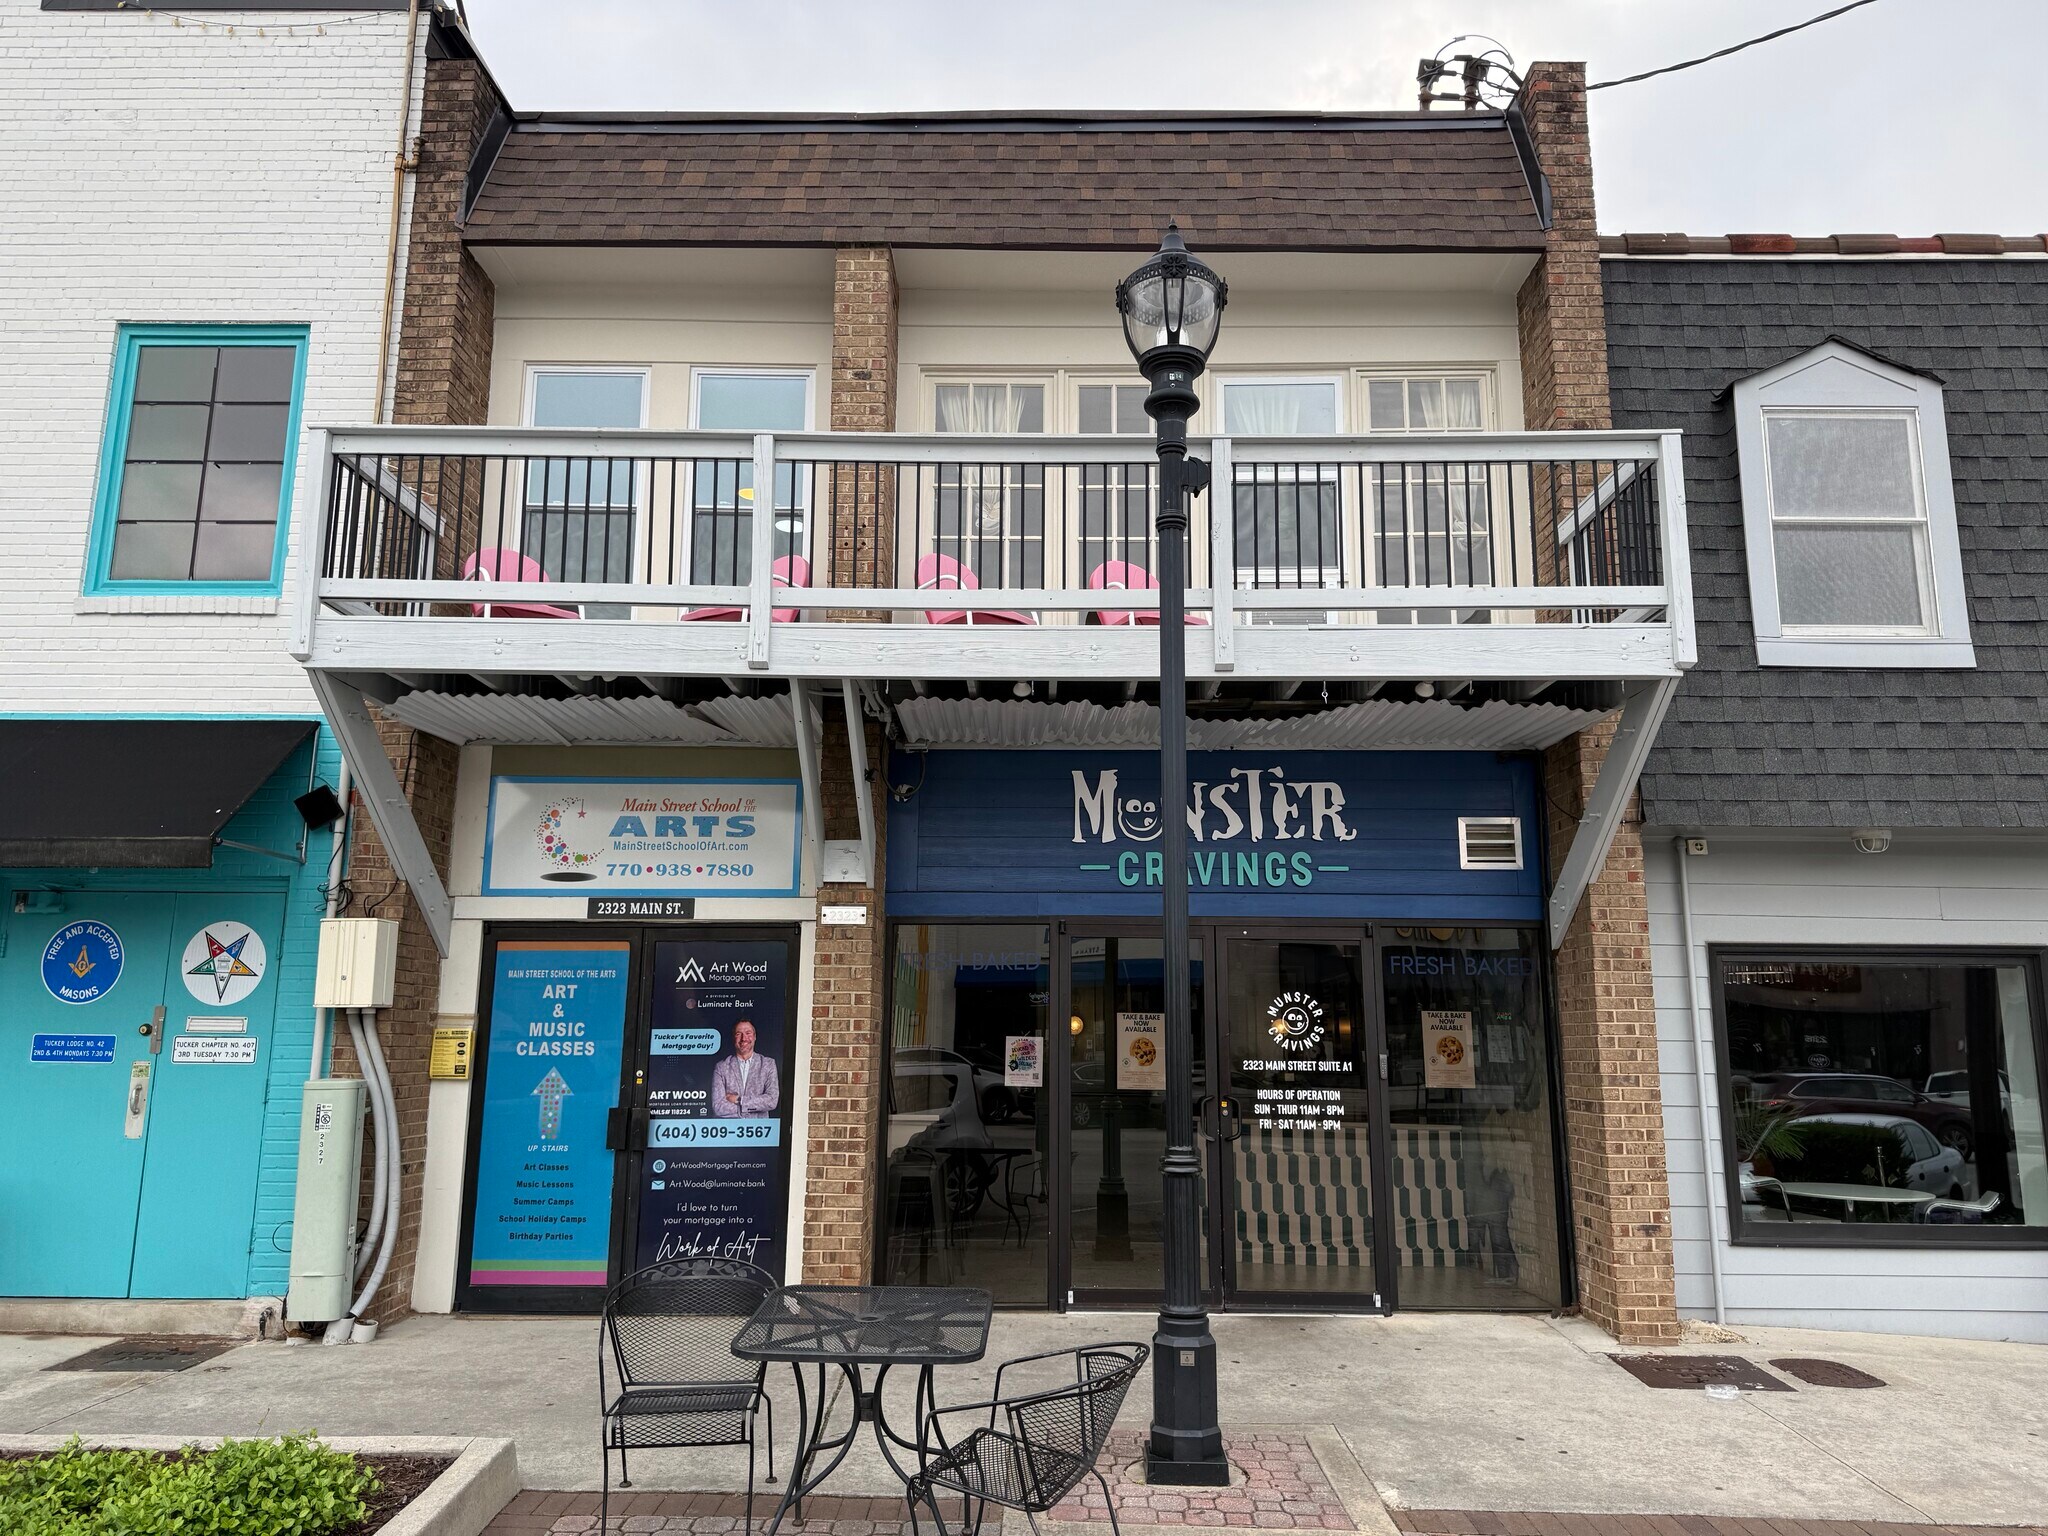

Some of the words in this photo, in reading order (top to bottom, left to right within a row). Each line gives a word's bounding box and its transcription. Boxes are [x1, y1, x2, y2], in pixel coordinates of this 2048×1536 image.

[620, 798, 656, 812] Main
[660, 798, 698, 812] Street
[699, 798, 742, 812] School
[608, 816, 756, 837] ARTS
[613, 841, 748, 851] MainStreetSchoolOfArt.com
[1118, 851, 1313, 887] CRVINGS
[598, 902, 626, 914] 2323
[630, 902, 662, 914] MAIN
[666, 902, 684, 914] ST.
[829, 910, 858, 921] 2323
[47, 938, 65, 960] FREE
[66, 926, 84, 939] AND
[86, 925, 119, 960] ACCEPTED
[710, 962, 728, 972] Art
[732, 961, 767, 972] Wood
[973, 952, 1041, 971] BAKED
[1390, 956, 1455, 975] FRESH
[1465, 957, 1534, 976] BAKED
[508, 970, 524, 978] MAIN
[525, 970, 548, 978] STREET
[550, 970, 574, 978] SCHOOL
[577, 970, 584, 978] OF
[587, 970, 598, 978] THE
[600, 970, 616, 978] ARTS
[709, 974, 745, 982] Mortgage
[59, 986, 99, 1000] MASONS
[542, 984, 578, 999] ART
[553, 1003, 564, 1018] &
[1267, 992, 1323, 1018] MUNSTER
[529, 1022, 585, 1037] MUSIC
[1268, 1026, 1324, 1051] CRAVINGS
[516, 1041, 595, 1056] CLASSES
[1243, 1060, 1264, 1070] 2323
[1265, 1060, 1286, 1070] MAIN
[1288, 1061, 1316, 1071] STREET
[1318, 1061, 1341, 1071] SUITE
[1343, 1062, 1352, 1071] A1
[650, 1091, 671, 1100] ART
[672, 1091, 707, 1100] WOOD
[1257, 1090, 1283, 1100] HOURS
[1285, 1090, 1295, 1100] OF
[1297, 1090, 1340, 1100] OPERATION
[1254, 1104, 1270, 1114] SUN
[1277, 1105, 1298, 1115] THUR
[1300, 1105, 1320, 1115] 11AM
[1327, 1105, 1344, 1116] 8PM
[1259, 1119, 1272, 1129] FRI
[1278, 1120, 1294, 1129] SAT
[1295, 1120, 1316, 1130] 11AM
[1324, 1120, 1341, 1130] 9PM
[655, 1124, 697, 1142] (404)
[701, 1126, 771, 1138] 909-3567
[670, 1161, 766, 1170] ArtWoodMortgageTeam.com
[669, 1179, 766, 1189] Art.Wood@luminate.bank
[548, 1198, 574, 1207] Camps
[677, 1203, 688, 1212] I'd
[690, 1203, 707, 1212] love
[710, 1204, 718, 1212] to
[721, 1204, 738, 1212] turn
[528, 1215, 558, 1224] Holiday
[560, 1216, 586, 1224] Camps
[663, 1217, 681, 1225] your
[684, 1216, 726, 1225] mortgage
[509, 1232, 543, 1241] Birthday
[656, 1232, 703, 1262] Work
[707, 1236, 720, 1266] of
[724, 1230, 771, 1264] Art
